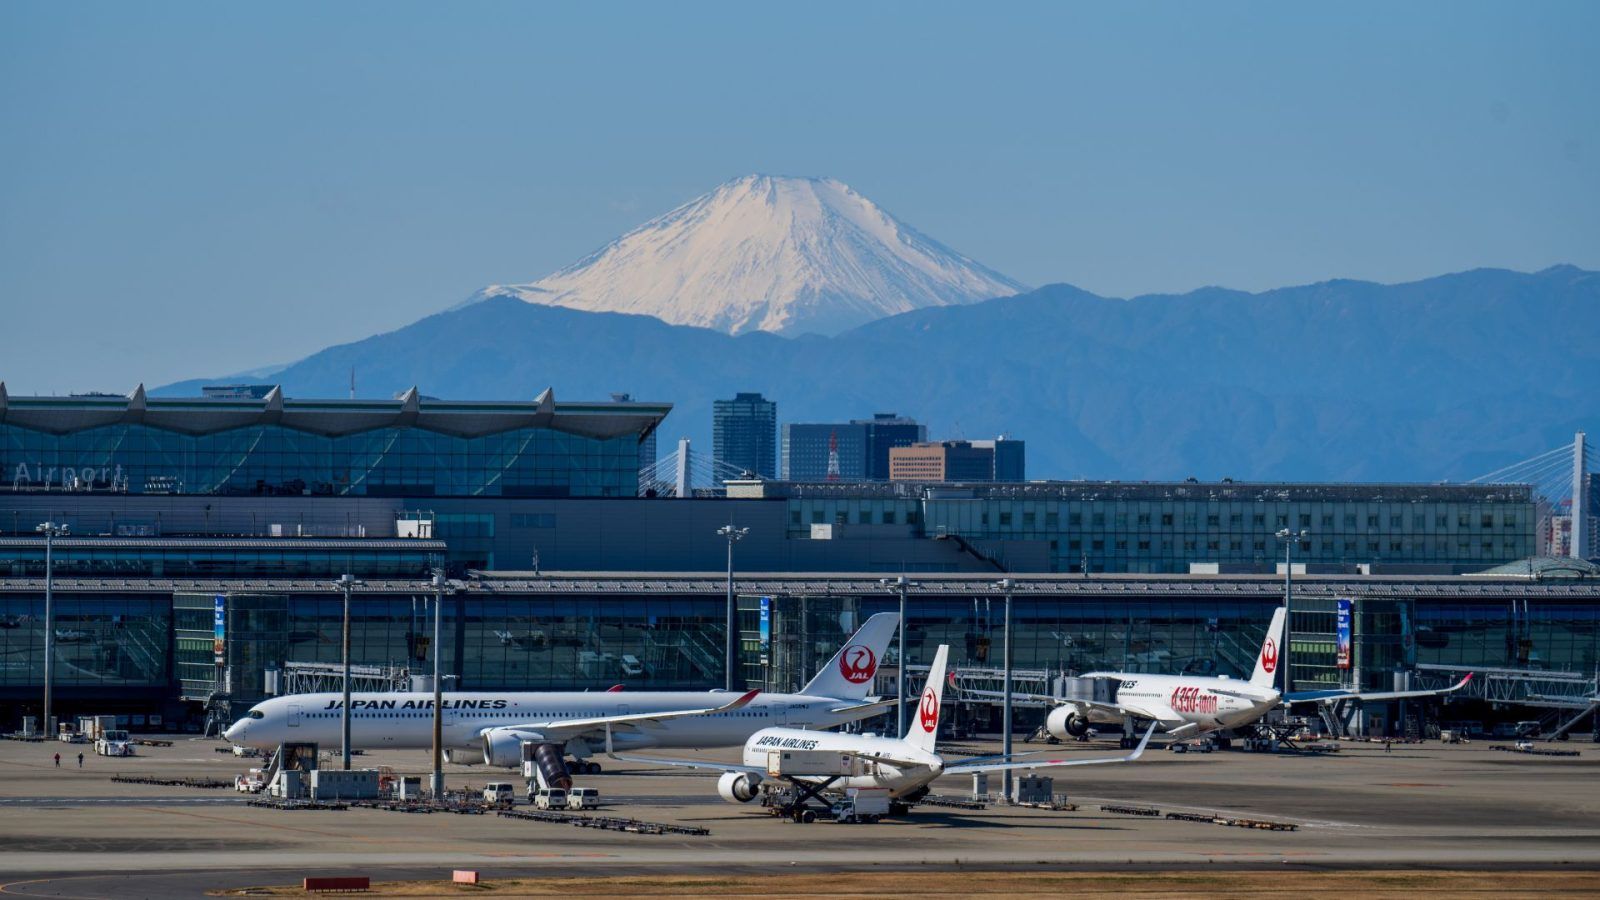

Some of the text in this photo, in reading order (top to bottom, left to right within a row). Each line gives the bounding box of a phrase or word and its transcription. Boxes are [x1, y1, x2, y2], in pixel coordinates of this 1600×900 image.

[14, 462, 125, 486] Airport
[849, 672, 869, 680] JAL
[324, 700, 507, 710] JAPAN AIRLINES
[1171, 686, 1218, 713] A350-1000
[924, 719, 935, 728] JAL
[756, 735, 818, 750] JAPAN AIRLINES
